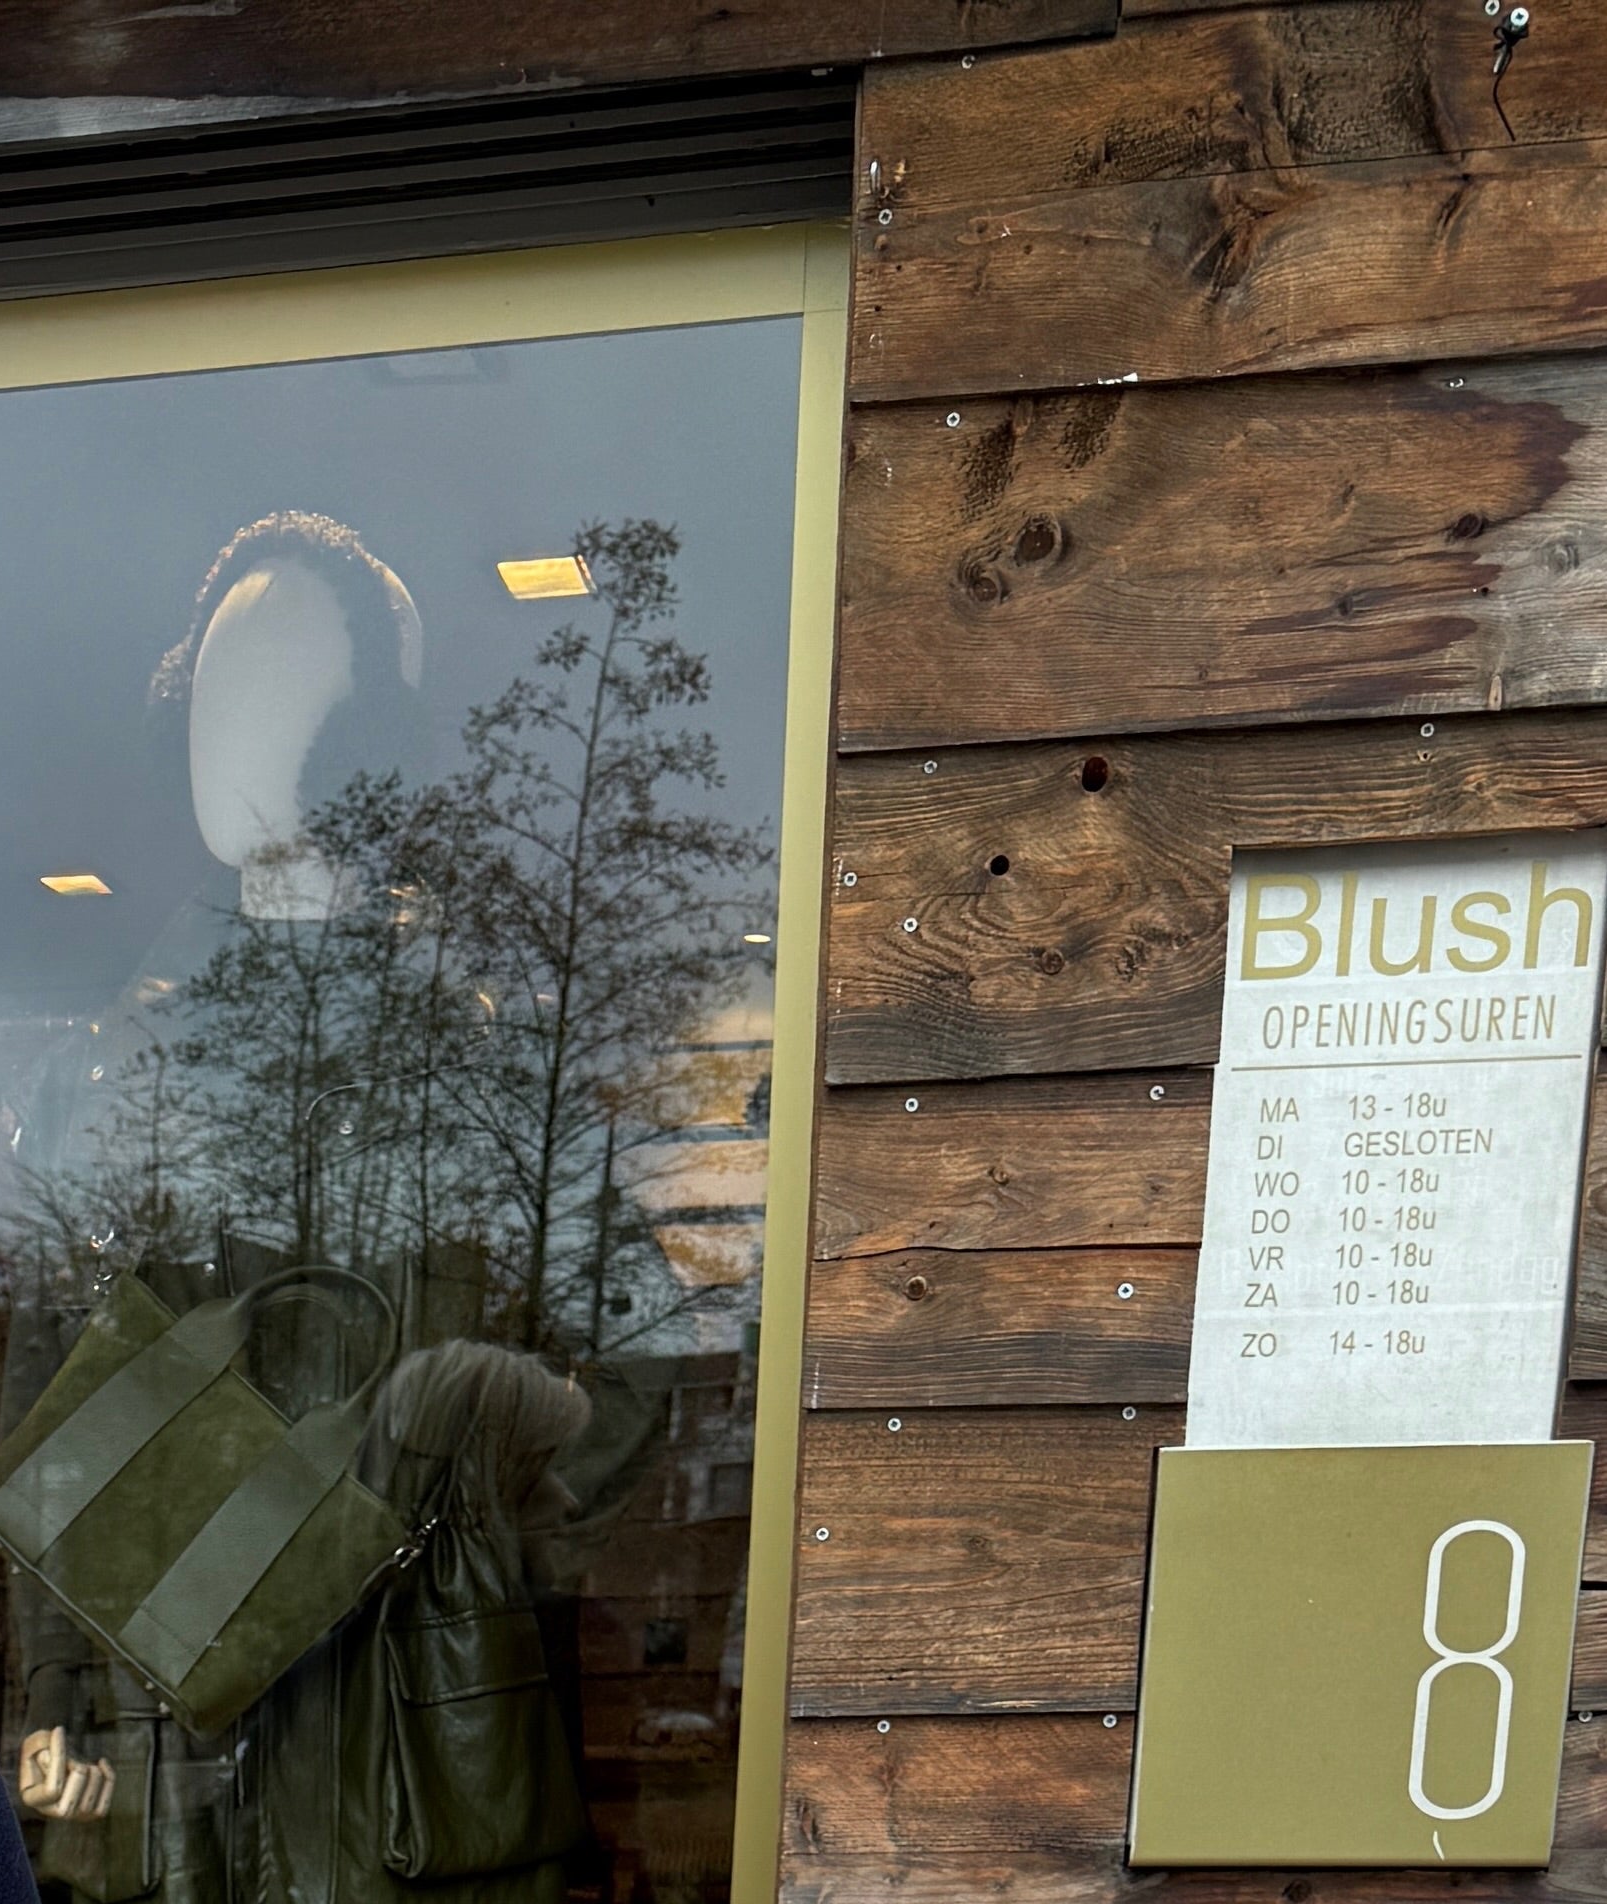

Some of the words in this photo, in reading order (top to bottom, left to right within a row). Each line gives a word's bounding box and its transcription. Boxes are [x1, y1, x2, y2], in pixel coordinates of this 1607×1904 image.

[1240, 860, 1594, 981] Blush
[1262, 994, 1556, 1050] OPENINGSUREN
[1260, 1097, 1300, 1124] MA
[1348, 1094, 1376, 1121] 13
[1403, 1092, 1447, 1118] 18u
[1257, 1135, 1283, 1161] DI
[1344, 1127, 1493, 1158] GESLOTEN
[1254, 1171, 1300, 1198] WO
[1342, 1169, 1370, 1195] 10
[1396, 1167, 1440, 1194] 18u
[1251, 1208, 1291, 1235] DO
[1339, 1206, 1366, 1233] 10
[1394, 1205, 1437, 1231] 18u
[1248, 1246, 1284, 1271] VR
[1335, 1243, 1363, 1269] 10
[1390, 1242, 1433, 1268] 18u
[1244, 1282, 1278, 1308] ZA
[1332, 1280, 1360, 1306] 10
[1387, 1279, 1429, 1305] 18u
[1240, 1332, 1277, 1358] ZO
[1329, 1330, 1356, 1355] 14
[1383, 1329, 1426, 1355] 18u
[1408, 1519, 1526, 1820] 8
